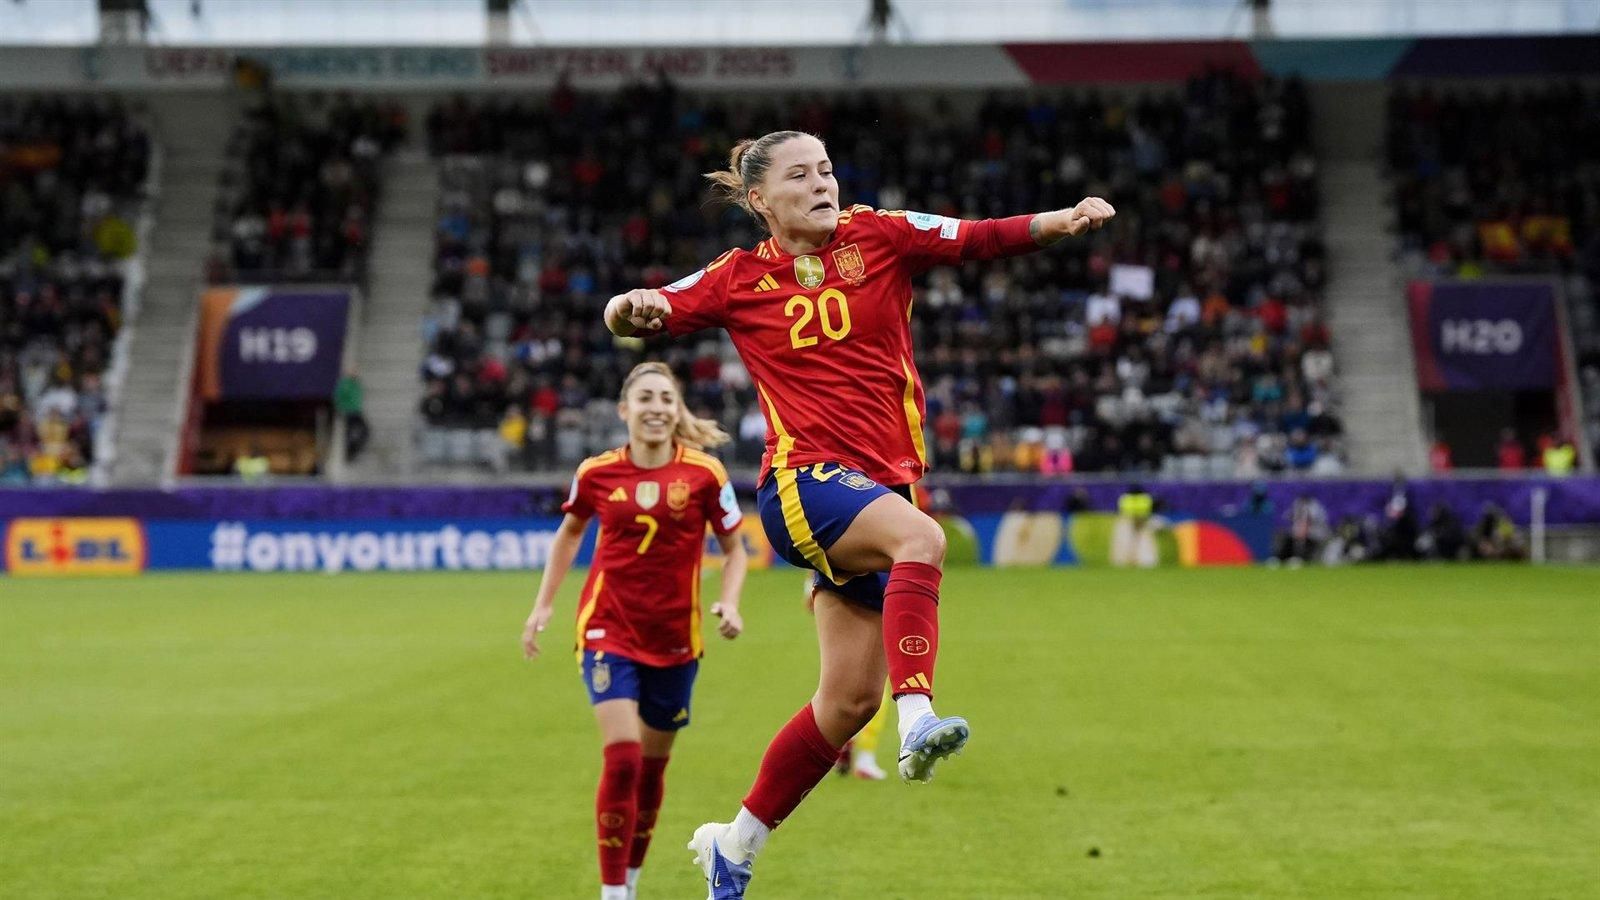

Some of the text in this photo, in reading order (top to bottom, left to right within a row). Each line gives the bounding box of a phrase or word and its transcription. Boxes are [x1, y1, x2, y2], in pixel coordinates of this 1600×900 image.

[146, 50, 234, 77] UEFA
[394, 50, 473, 77] EURO
[485, 50, 704, 76] SWITZERLAND
[714, 51, 795, 77] 2025
[784, 288, 852, 349] 20
[1441, 318, 1523, 354] H20
[238, 326, 317, 363] H19
[635, 514, 659, 555] 7
